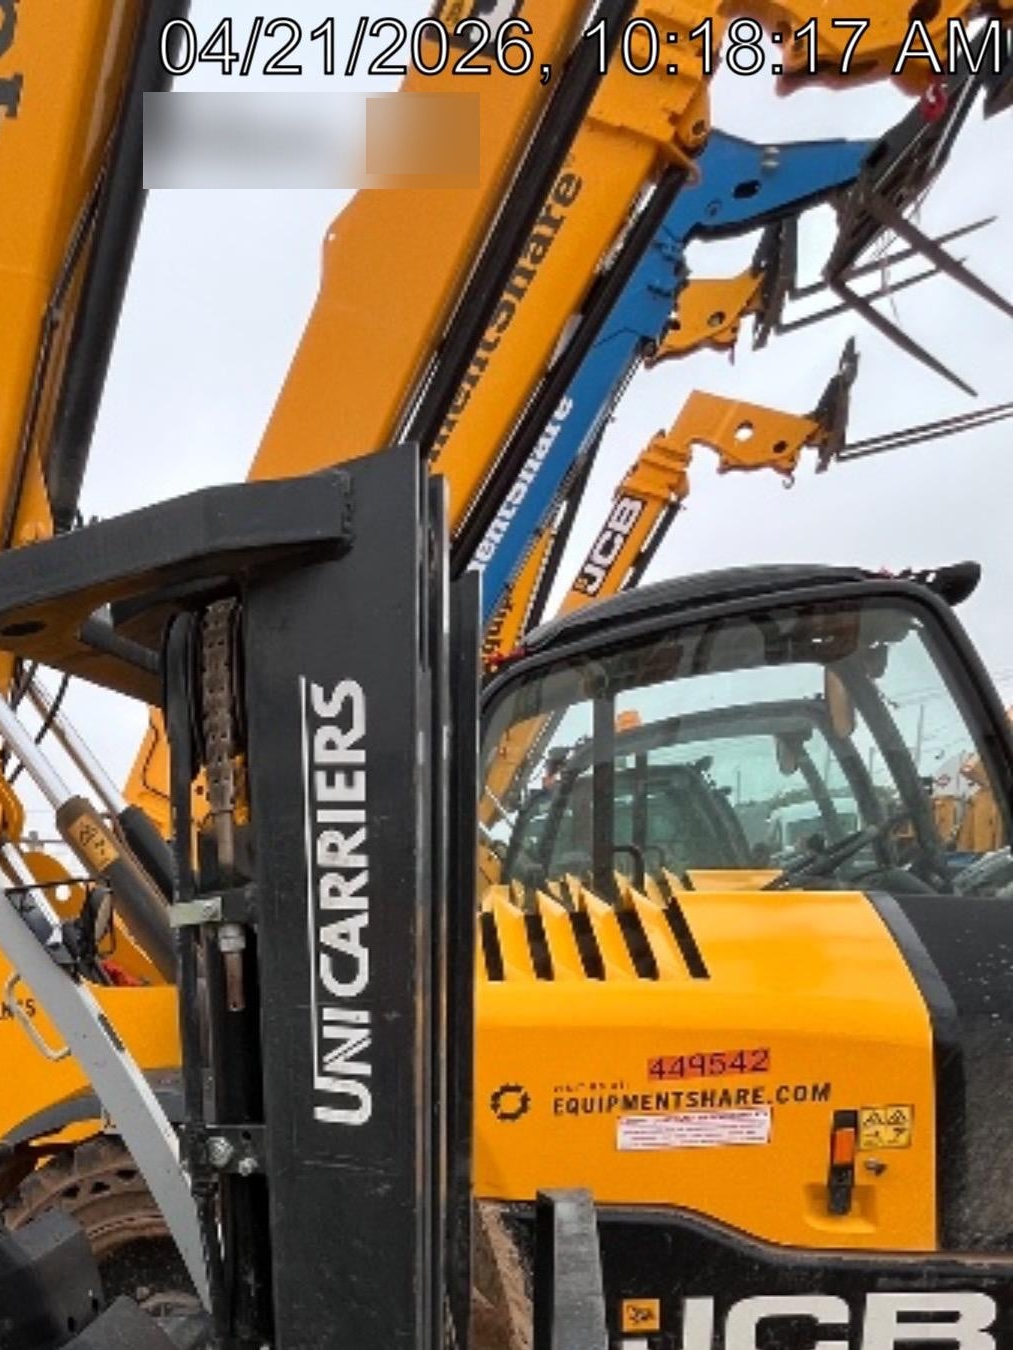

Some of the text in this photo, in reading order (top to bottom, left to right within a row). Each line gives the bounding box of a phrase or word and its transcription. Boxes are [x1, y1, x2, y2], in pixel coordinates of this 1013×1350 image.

[584, 498, 645, 596] JCB
[303, 676, 374, 1126] UNICARRIERS
[649, 1047, 771, 1080] 449542
[553, 1081, 832, 1117] EQUIPMENTSHARE.COM
